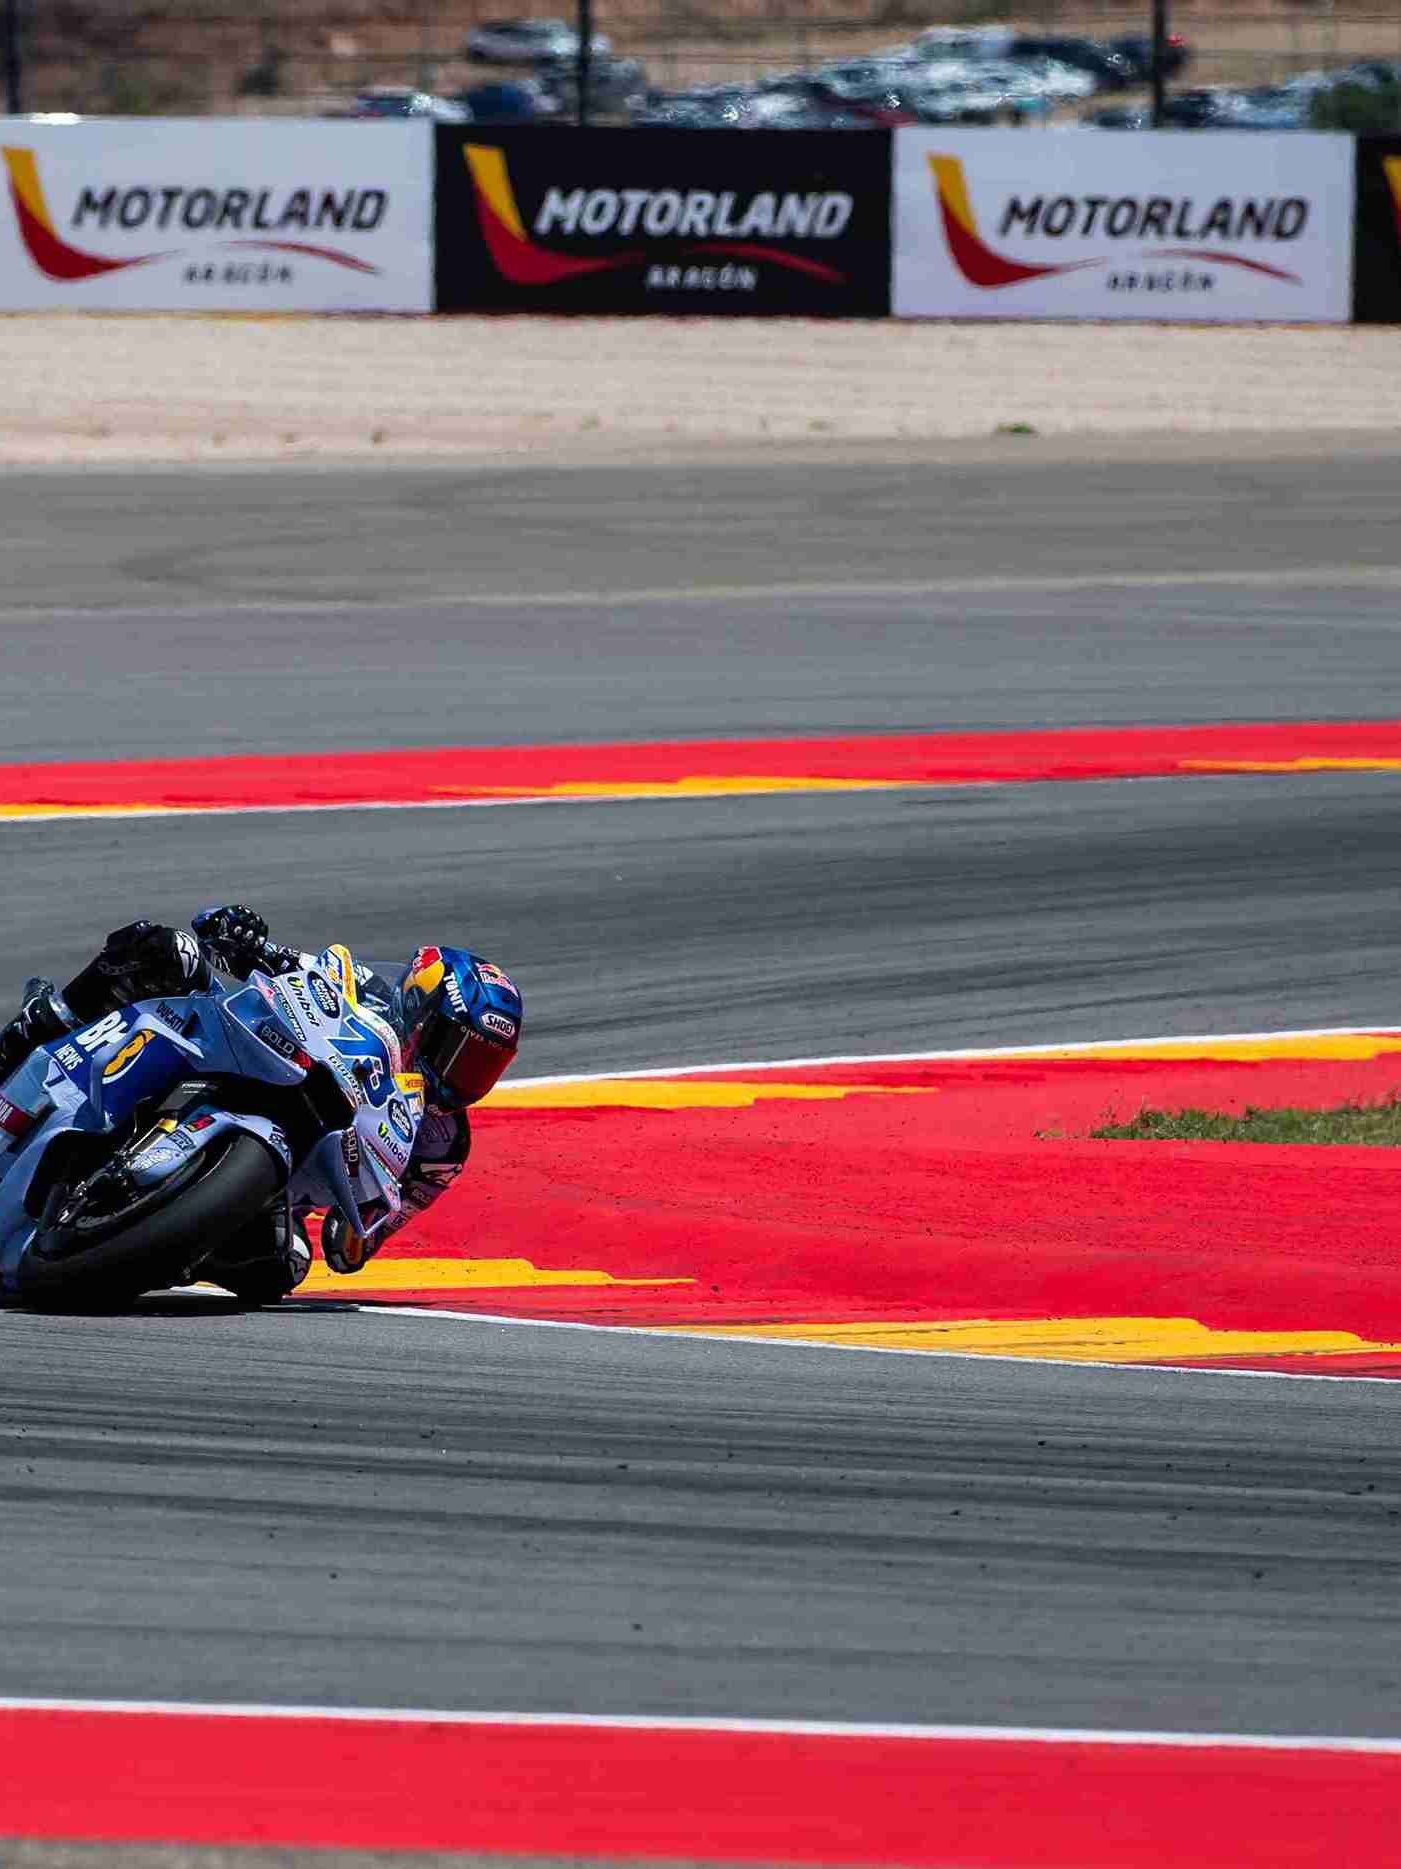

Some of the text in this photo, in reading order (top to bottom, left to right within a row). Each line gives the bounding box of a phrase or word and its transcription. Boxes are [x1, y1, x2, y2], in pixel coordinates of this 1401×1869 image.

[71, 186, 390, 232] MOTORLAND
[535, 188, 854, 238] MOTORLAND
[999, 195, 1311, 242] MOTORLAND
[53, 1043, 84, 1071] NEWS
[261, 1026, 295, 1055] BOLD
